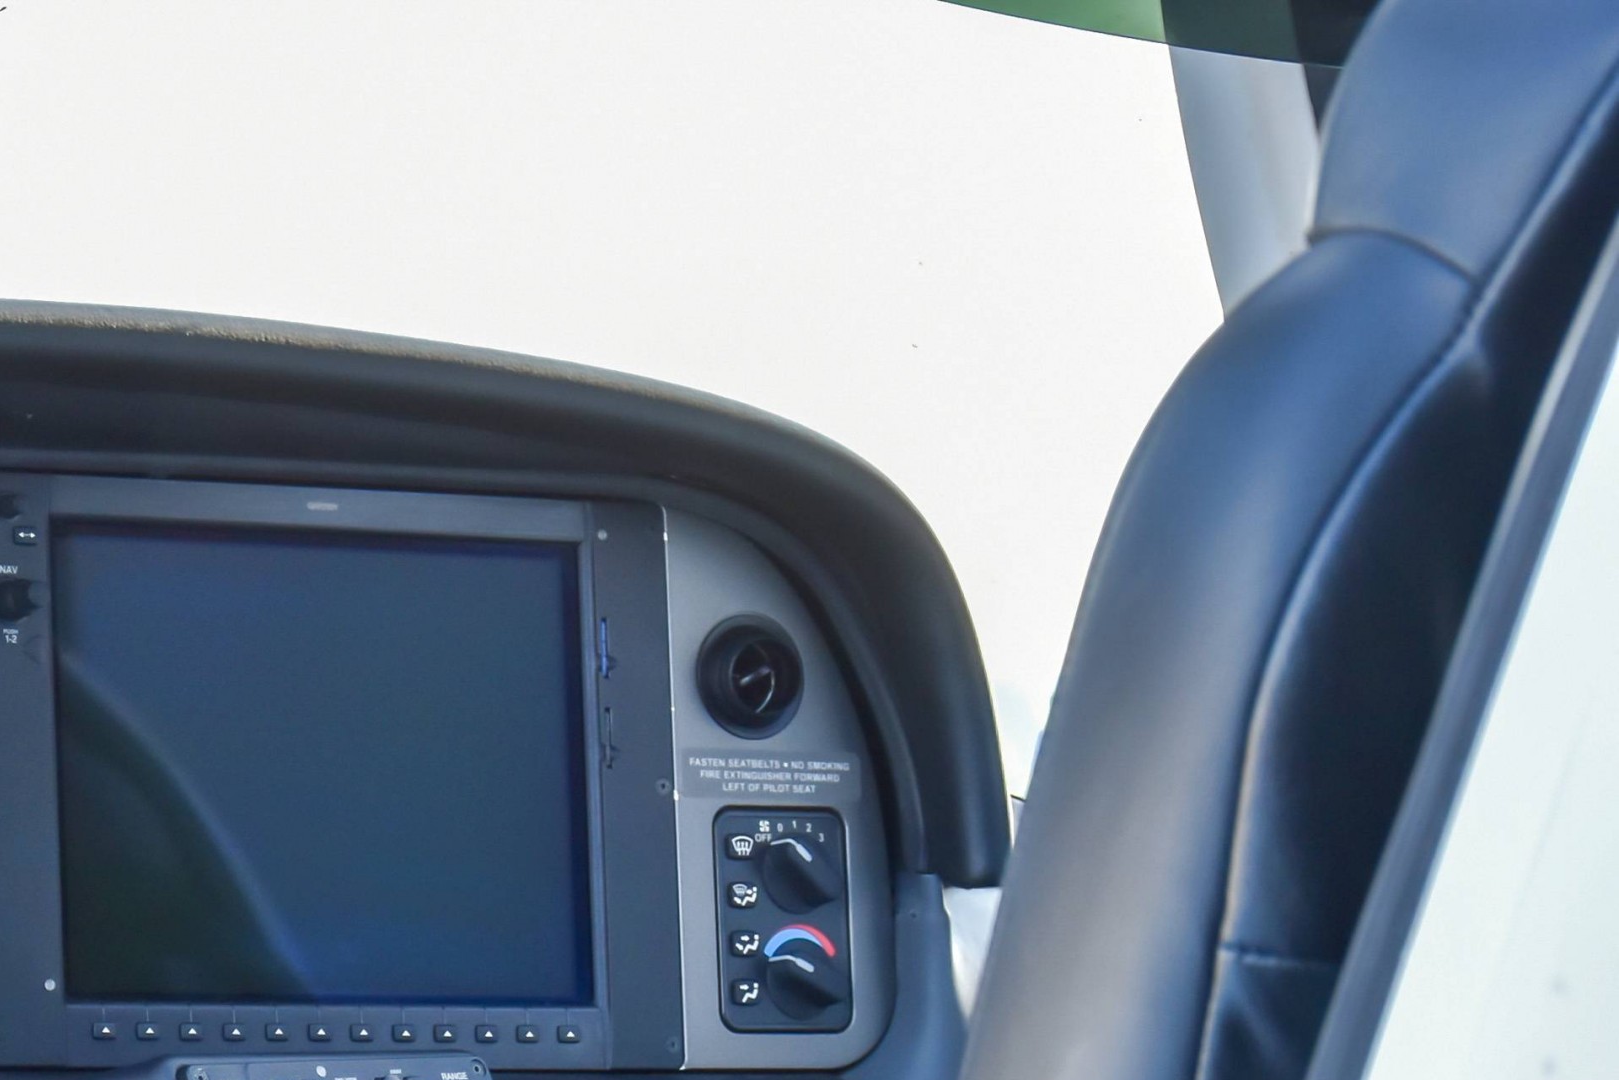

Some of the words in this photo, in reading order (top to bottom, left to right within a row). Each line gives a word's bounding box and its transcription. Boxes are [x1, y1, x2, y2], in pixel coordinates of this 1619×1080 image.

[0, 565, 18, 574] NAV
[5, 635, 17, 644] 1-2
[689, 757, 726, 768] FASTEN
[728, 758, 781, 769] SEATBELTS
[791, 761, 805, 770] NO
[807, 761, 850, 772] SMOKING
[700, 770, 721, 780] FIRE
[723, 771, 792, 782] EXTINGUISHER
[794, 773, 841, 783] FORWARD
[722, 783, 745, 792] LEFT
[748, 783, 761, 792] OF
[762, 784, 790, 793] PILOT
[792, 784, 816, 794] SEAT
[777, 823, 783, 832] 0
[792, 820, 797, 829] 1
[806, 823, 812, 832] 2
[818, 833, 825, 842] 3
[755, 833, 772, 842] OFF
[440, 1072, 469, 1080] RANGE
